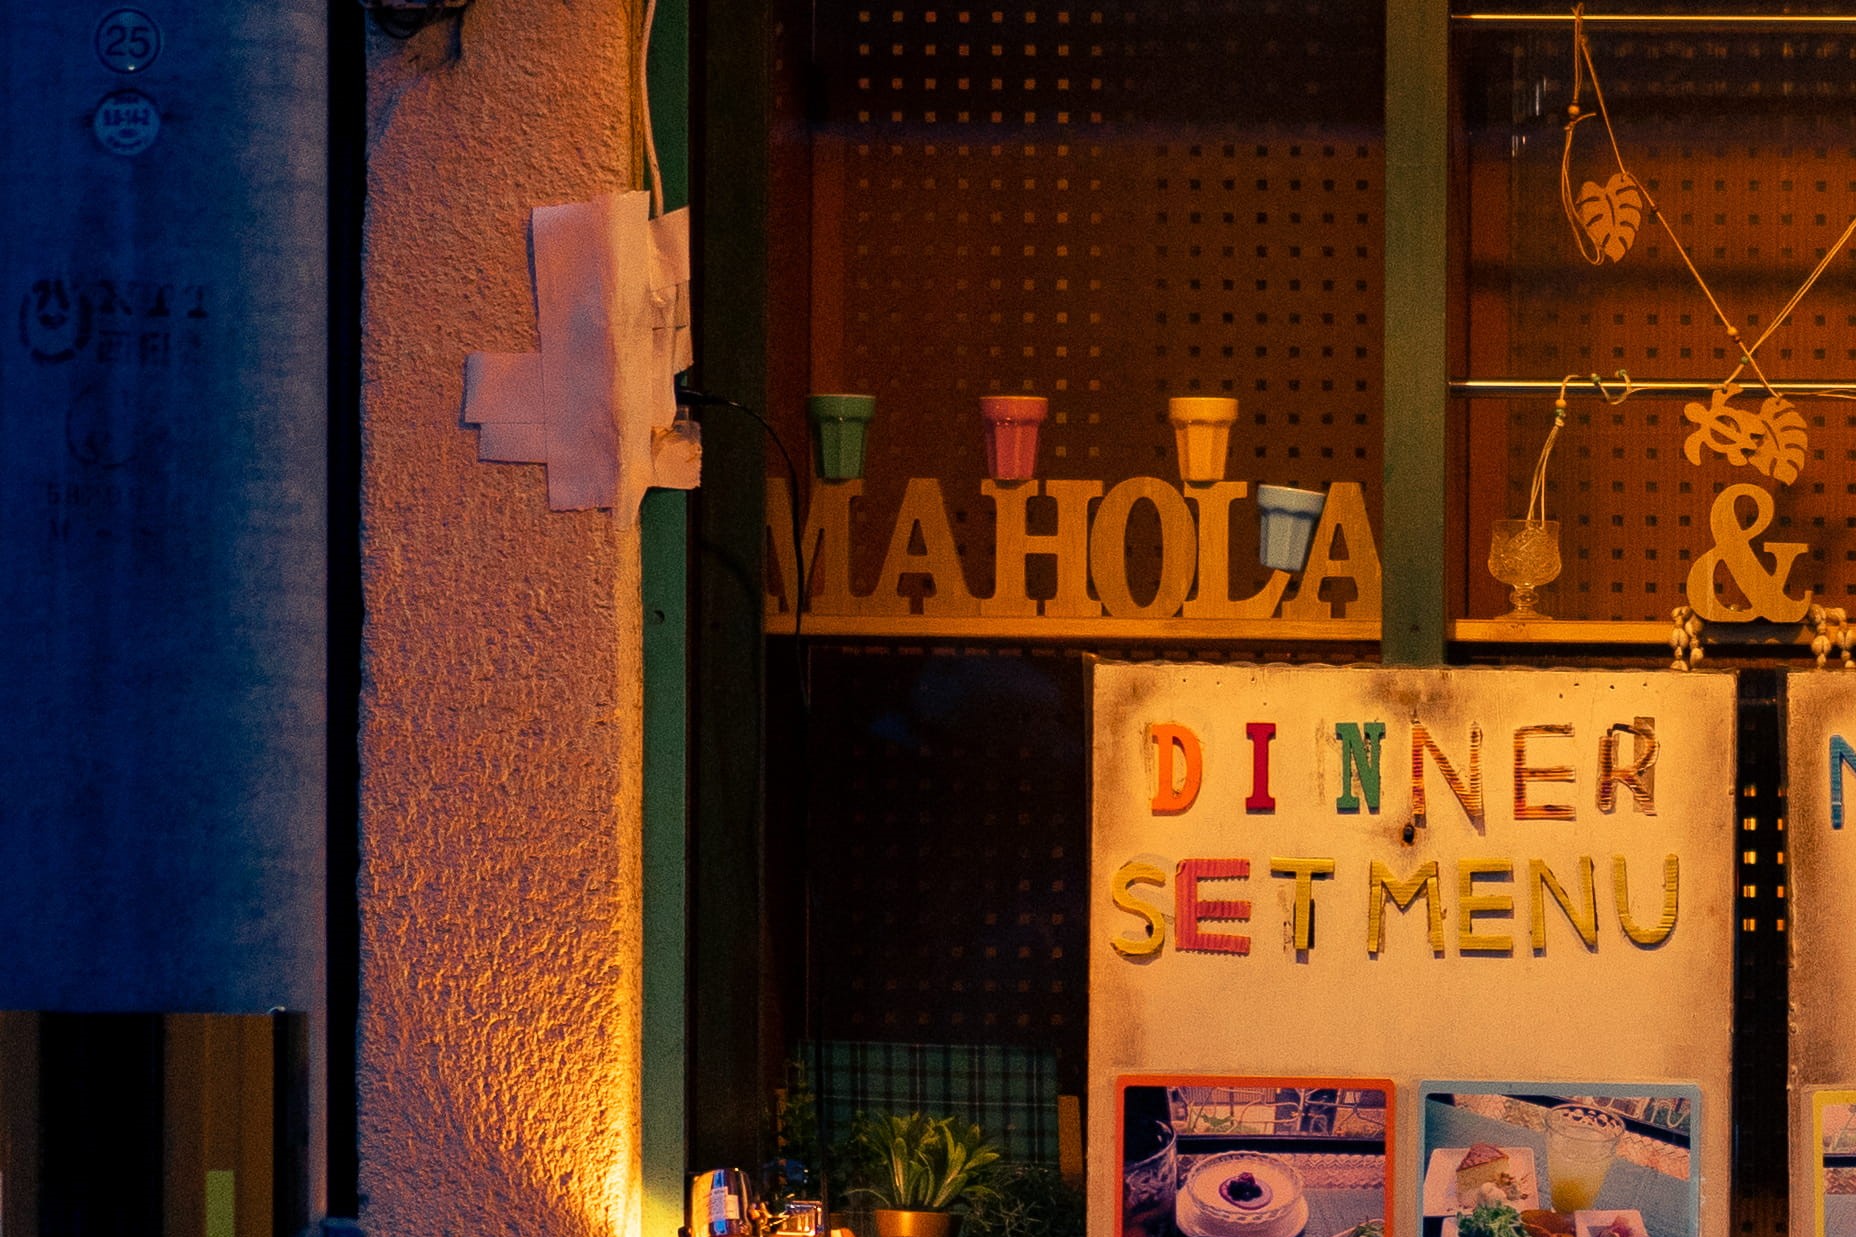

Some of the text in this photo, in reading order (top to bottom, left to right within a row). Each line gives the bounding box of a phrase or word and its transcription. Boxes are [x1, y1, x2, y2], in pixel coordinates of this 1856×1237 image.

[106, 24, 150, 59] 25
[765, 476, 1383, 618] MAHOLA
[1678, 484, 1804, 622] &
[1150, 720, 1658, 822] DINNER
